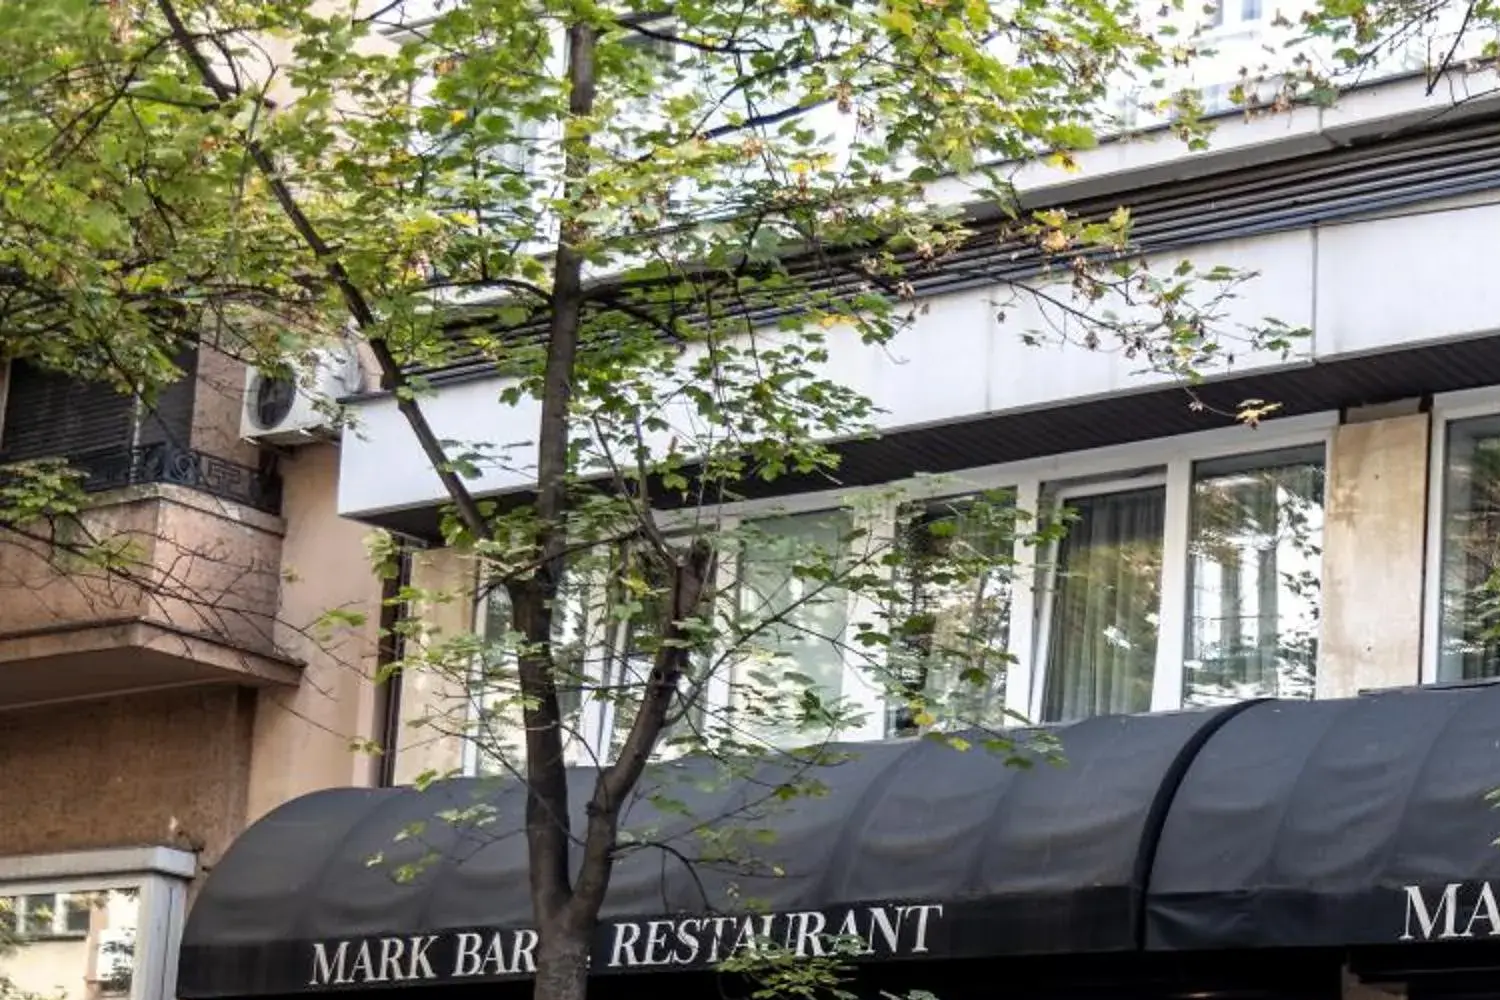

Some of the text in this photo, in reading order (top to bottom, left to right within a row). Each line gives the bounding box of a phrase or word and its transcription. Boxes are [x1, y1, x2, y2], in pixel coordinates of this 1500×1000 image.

[309, 903, 943, 985] MARK BAR RESTAURANT
